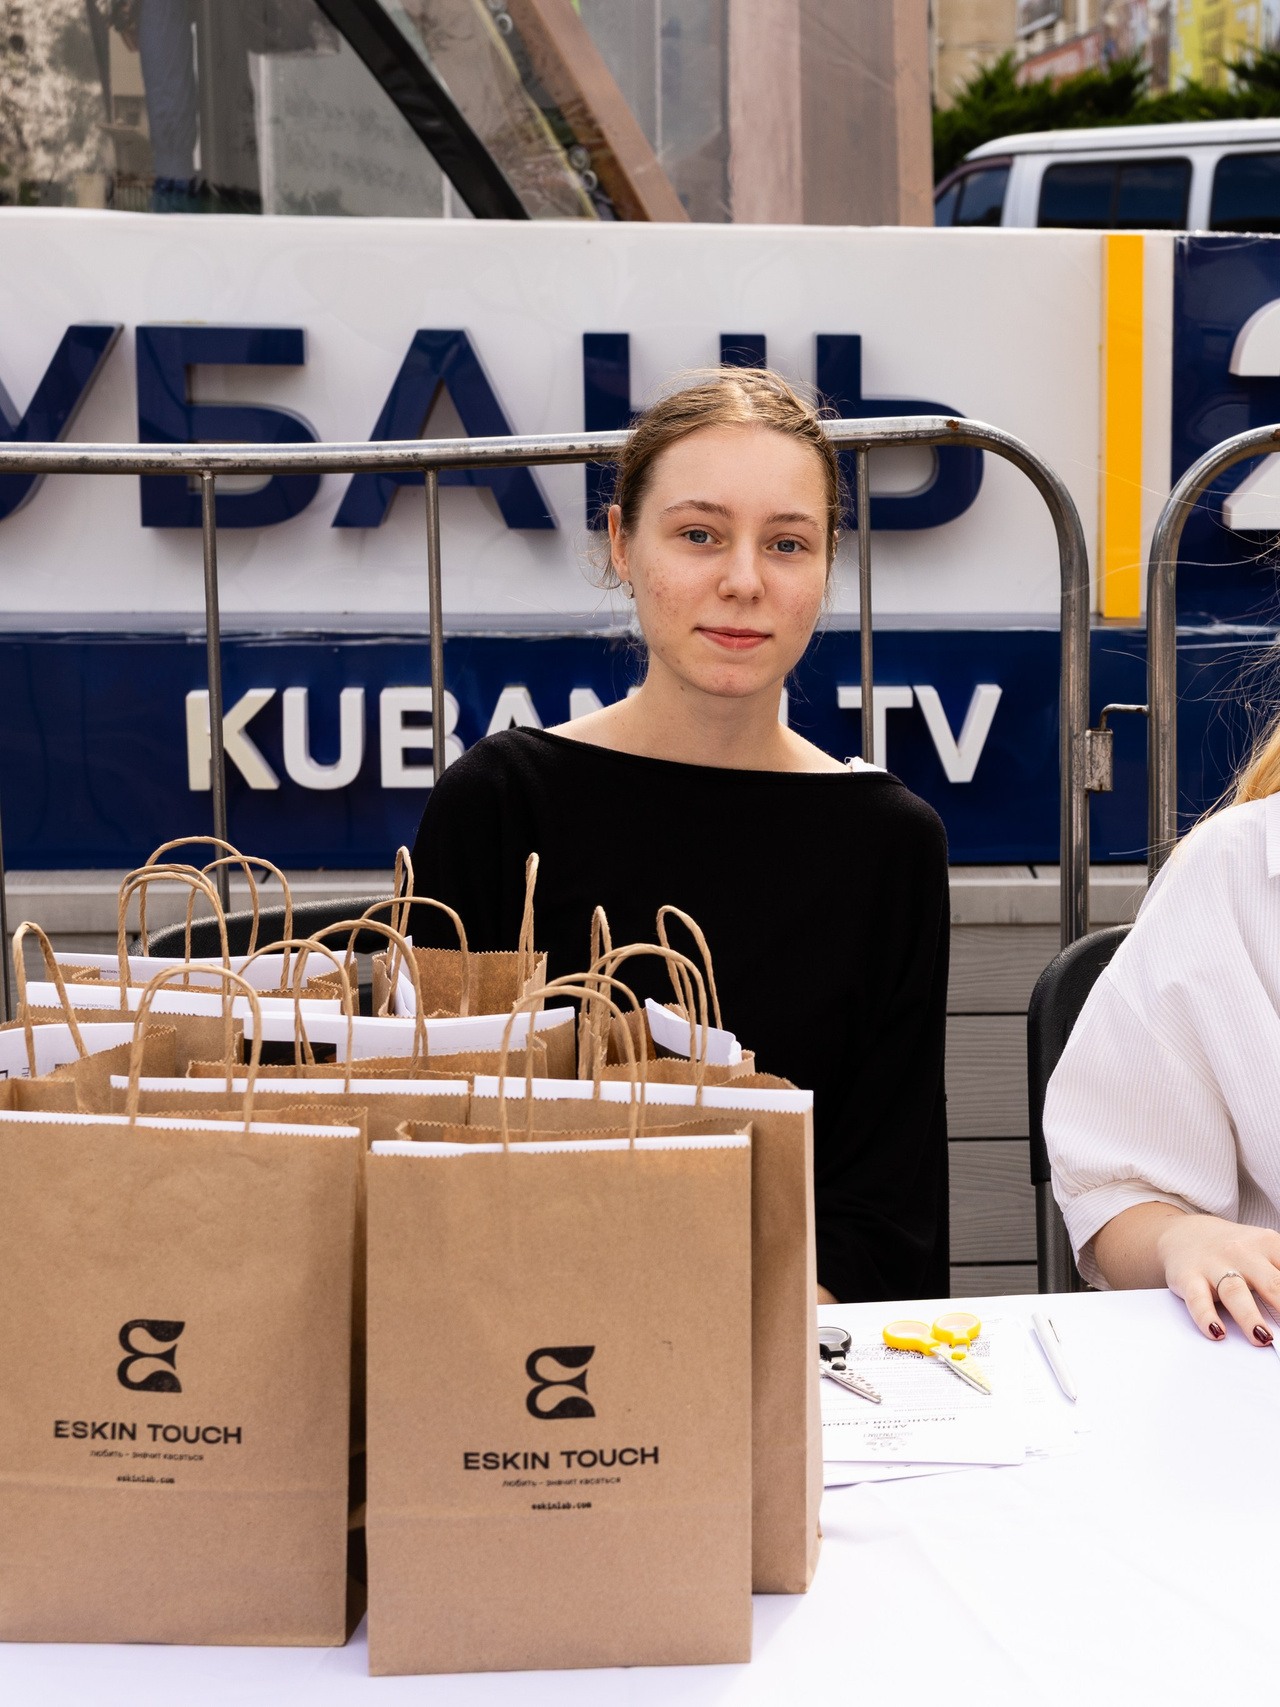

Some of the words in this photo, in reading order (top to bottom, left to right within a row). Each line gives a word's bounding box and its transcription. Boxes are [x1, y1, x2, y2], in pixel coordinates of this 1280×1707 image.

[185, 686, 643, 791] KUB
[837, 683, 1003, 784] TV
[54, 1420, 138, 1441] ESKIN
[146, 1423, 243, 1445] TOUCH
[90, 1449, 124, 1458] любить
[132, 1452, 162, 1460] значит
[163, 1453, 205, 1462] касаться
[463, 1451, 551, 1471] ESKIN
[559, 1446, 660, 1470] TOUCH
[116, 1474, 176, 1484] eskinlab.com
[502, 1479, 538, 1488] любить
[546, 1479, 578, 1487] значит
[580, 1476, 622, 1486] касаться
[531, 1501, 593, 1510] eskinlab.com
